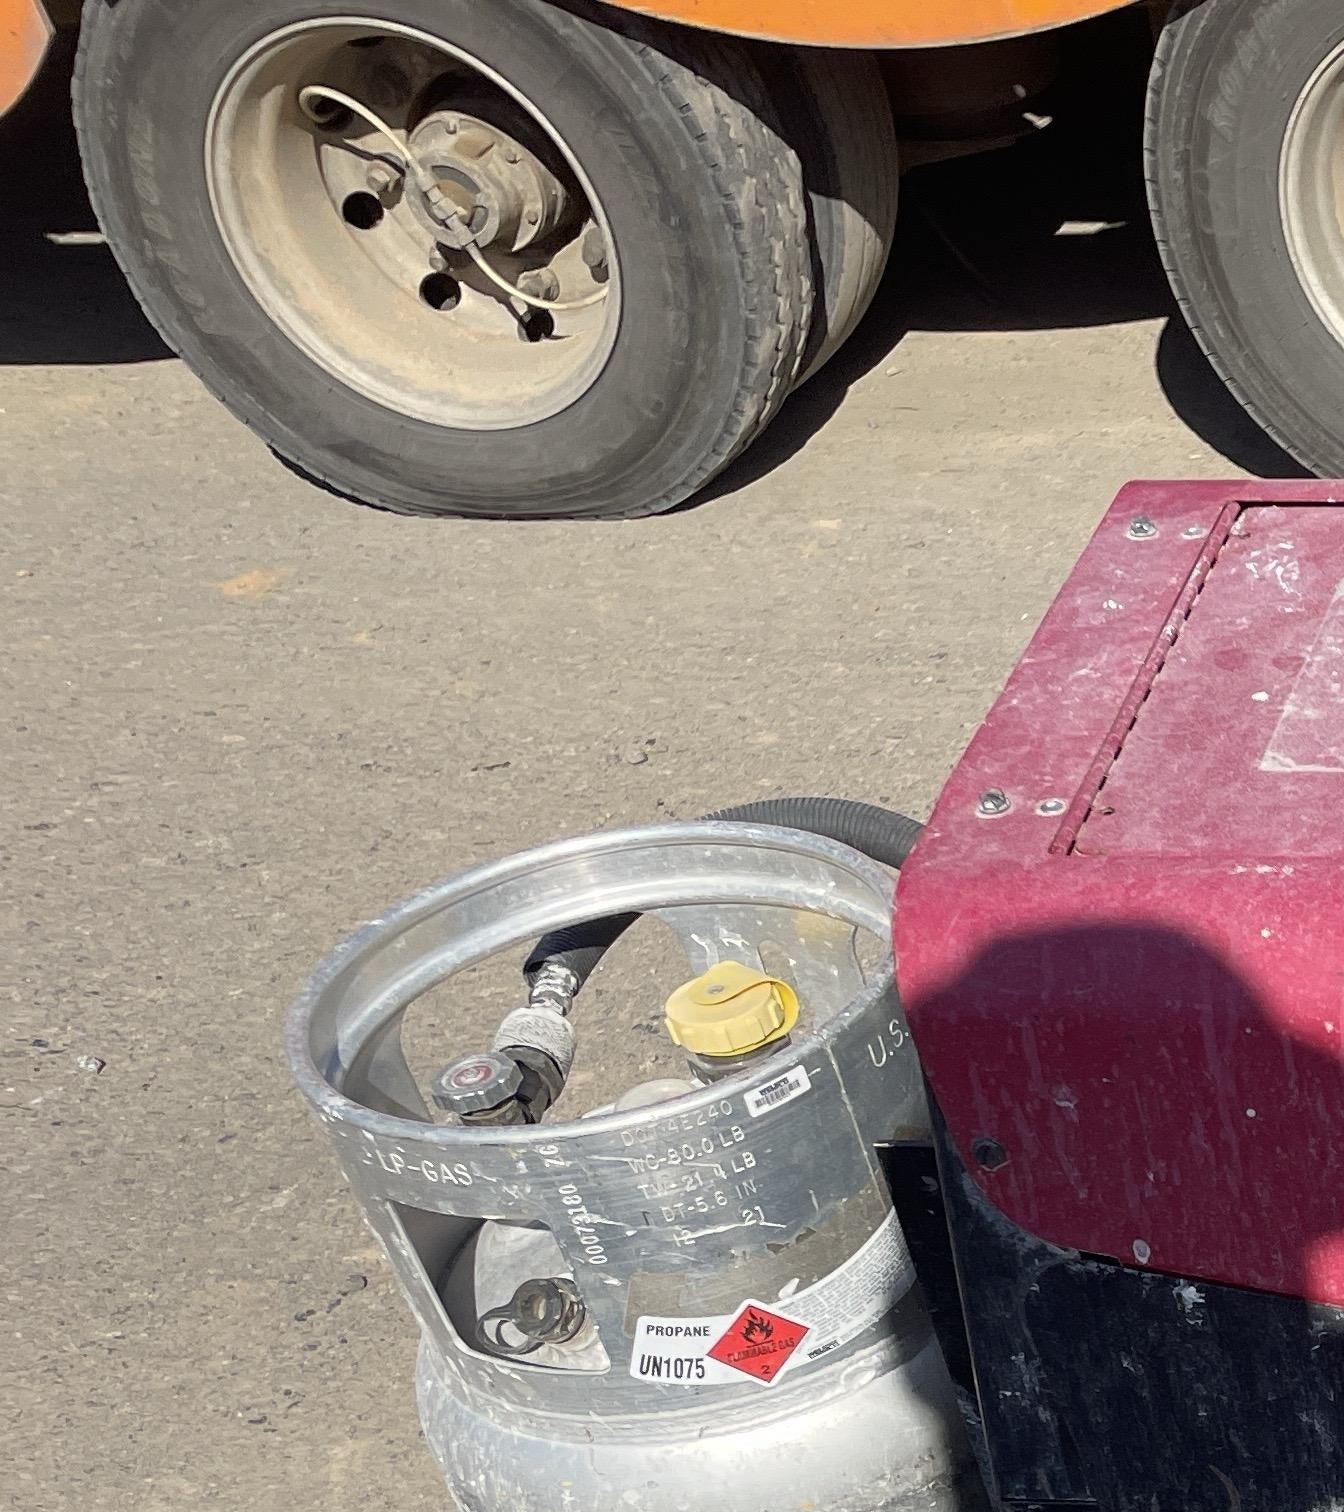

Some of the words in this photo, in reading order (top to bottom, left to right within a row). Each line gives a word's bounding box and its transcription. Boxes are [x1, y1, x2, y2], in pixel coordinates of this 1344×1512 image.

[868, 1019, 909, 1067] U.S.
[718, 1126, 745, 1148] LB
[375, 1149, 473, 1187] LP-GAS
[731, 1151, 757, 1174] LB
[646, 1324, 711, 1337] PROPANE
[726, 1343, 778, 1363] FLAMMABLE
[639, 1353, 706, 1380] UN1075
[760, 1364, 771, 1376] 2
